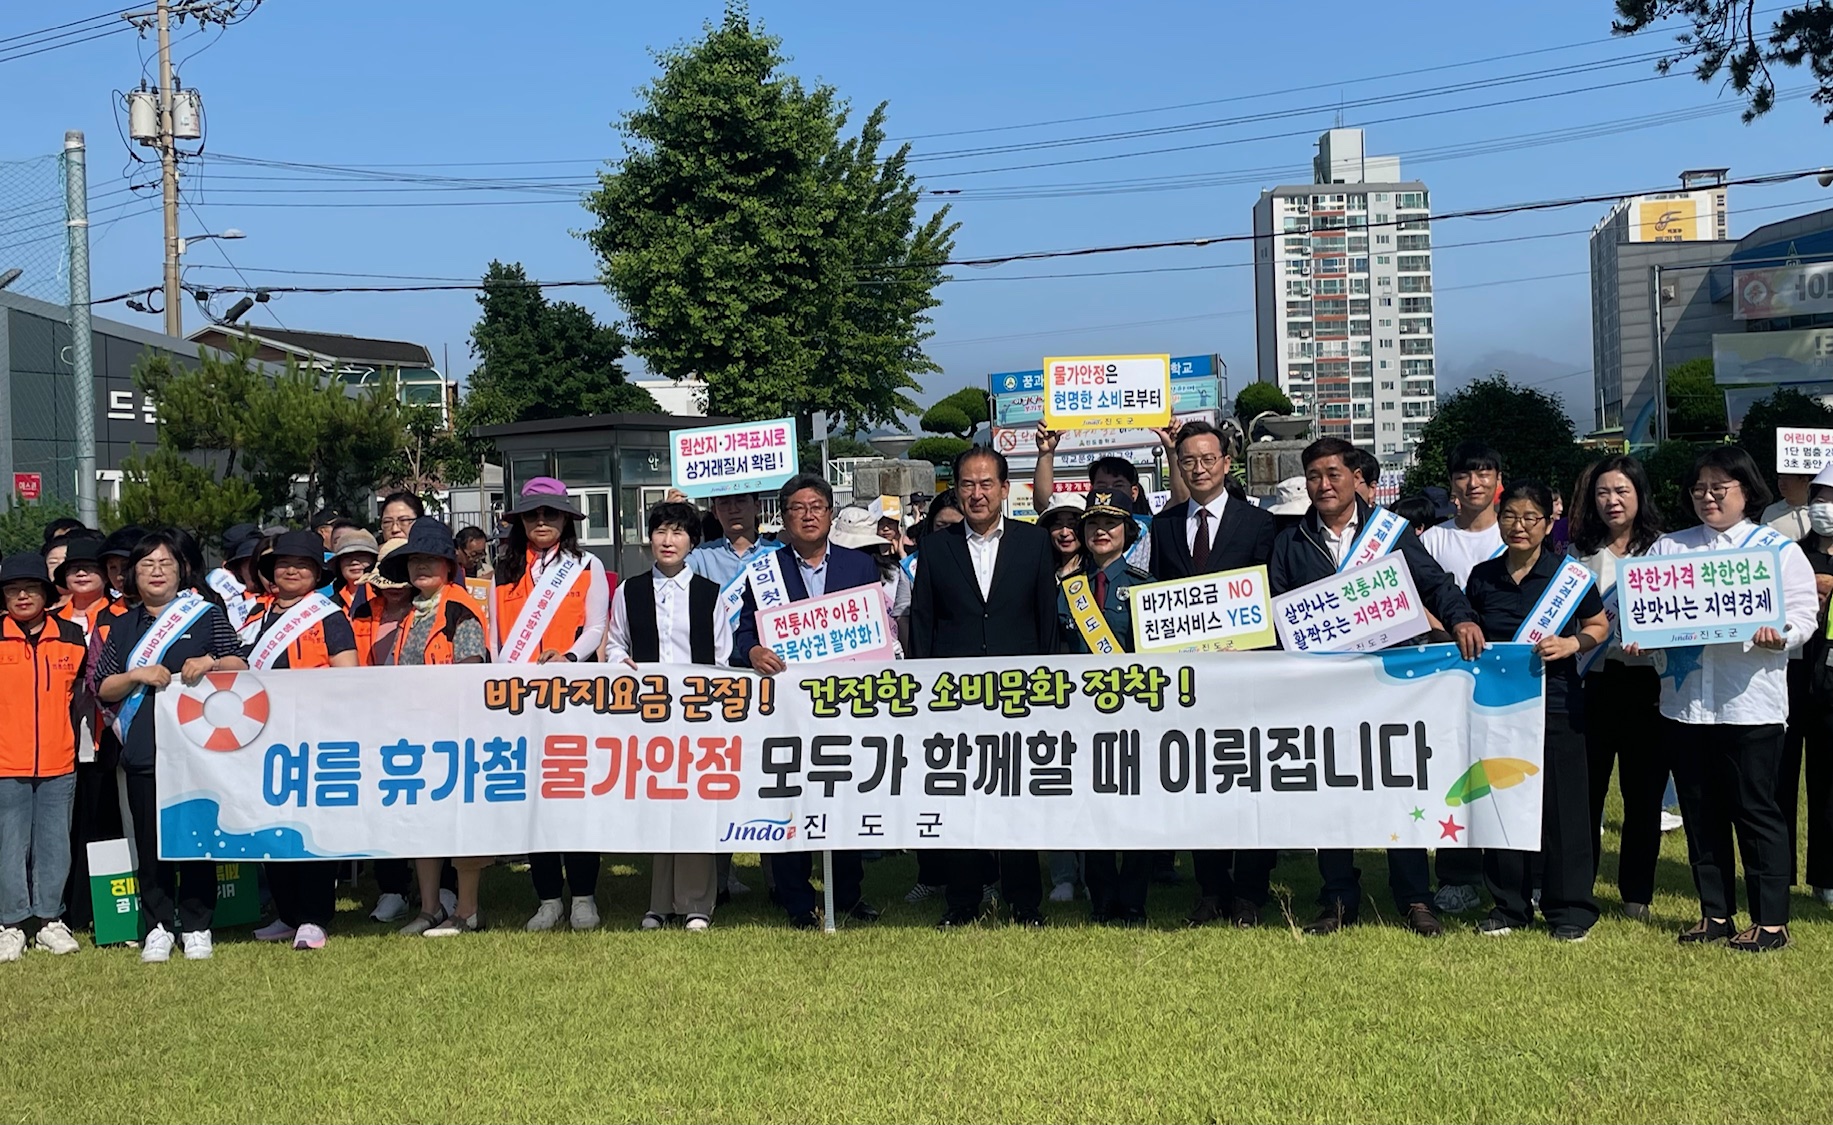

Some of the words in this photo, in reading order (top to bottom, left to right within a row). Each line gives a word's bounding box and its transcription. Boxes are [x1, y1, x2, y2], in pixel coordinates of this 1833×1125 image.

[1054, 364, 1118, 386] 물가안정은
[1054, 390, 1093, 411] 현명한
[1097, 388, 1161, 409] 소비로부터
[1784, 433, 1816, 445] 어린이
[1820, 434, 1833, 445] 보
[1803, 447, 1821, 457] 멈춤
[686, 456, 748, 480] 상거래질서
[1784, 459, 1799, 468] 3초
[1803, 459, 1822, 469] 동안
[1567, 564, 1588, 580] 2024
[1628, 562, 1695, 593] 착한가격
[1701, 558, 1771, 587] 착한업소
[1142, 583, 1219, 614] 바가지요금
[1228, 578, 1254, 599] NO
[1284, 591, 1340, 625] 살맛나는
[1341, 565, 1398, 602] 전통시장
[1537, 575, 1579, 630] 가격표시로
[1631, 595, 1699, 625] 살맛나는
[1705, 587, 1773, 618] 지역경제
[142, 613, 182, 659] 바가지요금
[508, 589, 555, 663] 의용소방대연합
[773, 606, 828, 639] 전통시장
[1144, 611, 1223, 642] 친절서비스
[1226, 605, 1262, 628] YES
[1293, 616, 1351, 651] 활짝웃는
[1353, 590, 1411, 626] 지역경제
[484, 674, 673, 722] 바가지요금
[800, 667, 920, 717] 건전한
[928, 665, 1076, 716] 소비문화
[262, 739, 363, 809] 여름
[378, 735, 528, 808] 휴가철
[540, 733, 742, 801] 물가안정
[757, 732, 908, 799] 모두가
[922, 727, 1078, 798] 함께할
[1091, 727, 1142, 797] 때
[1158, 719, 1433, 794] 이뤄집니다
[720, 820, 786, 842] Jindo
